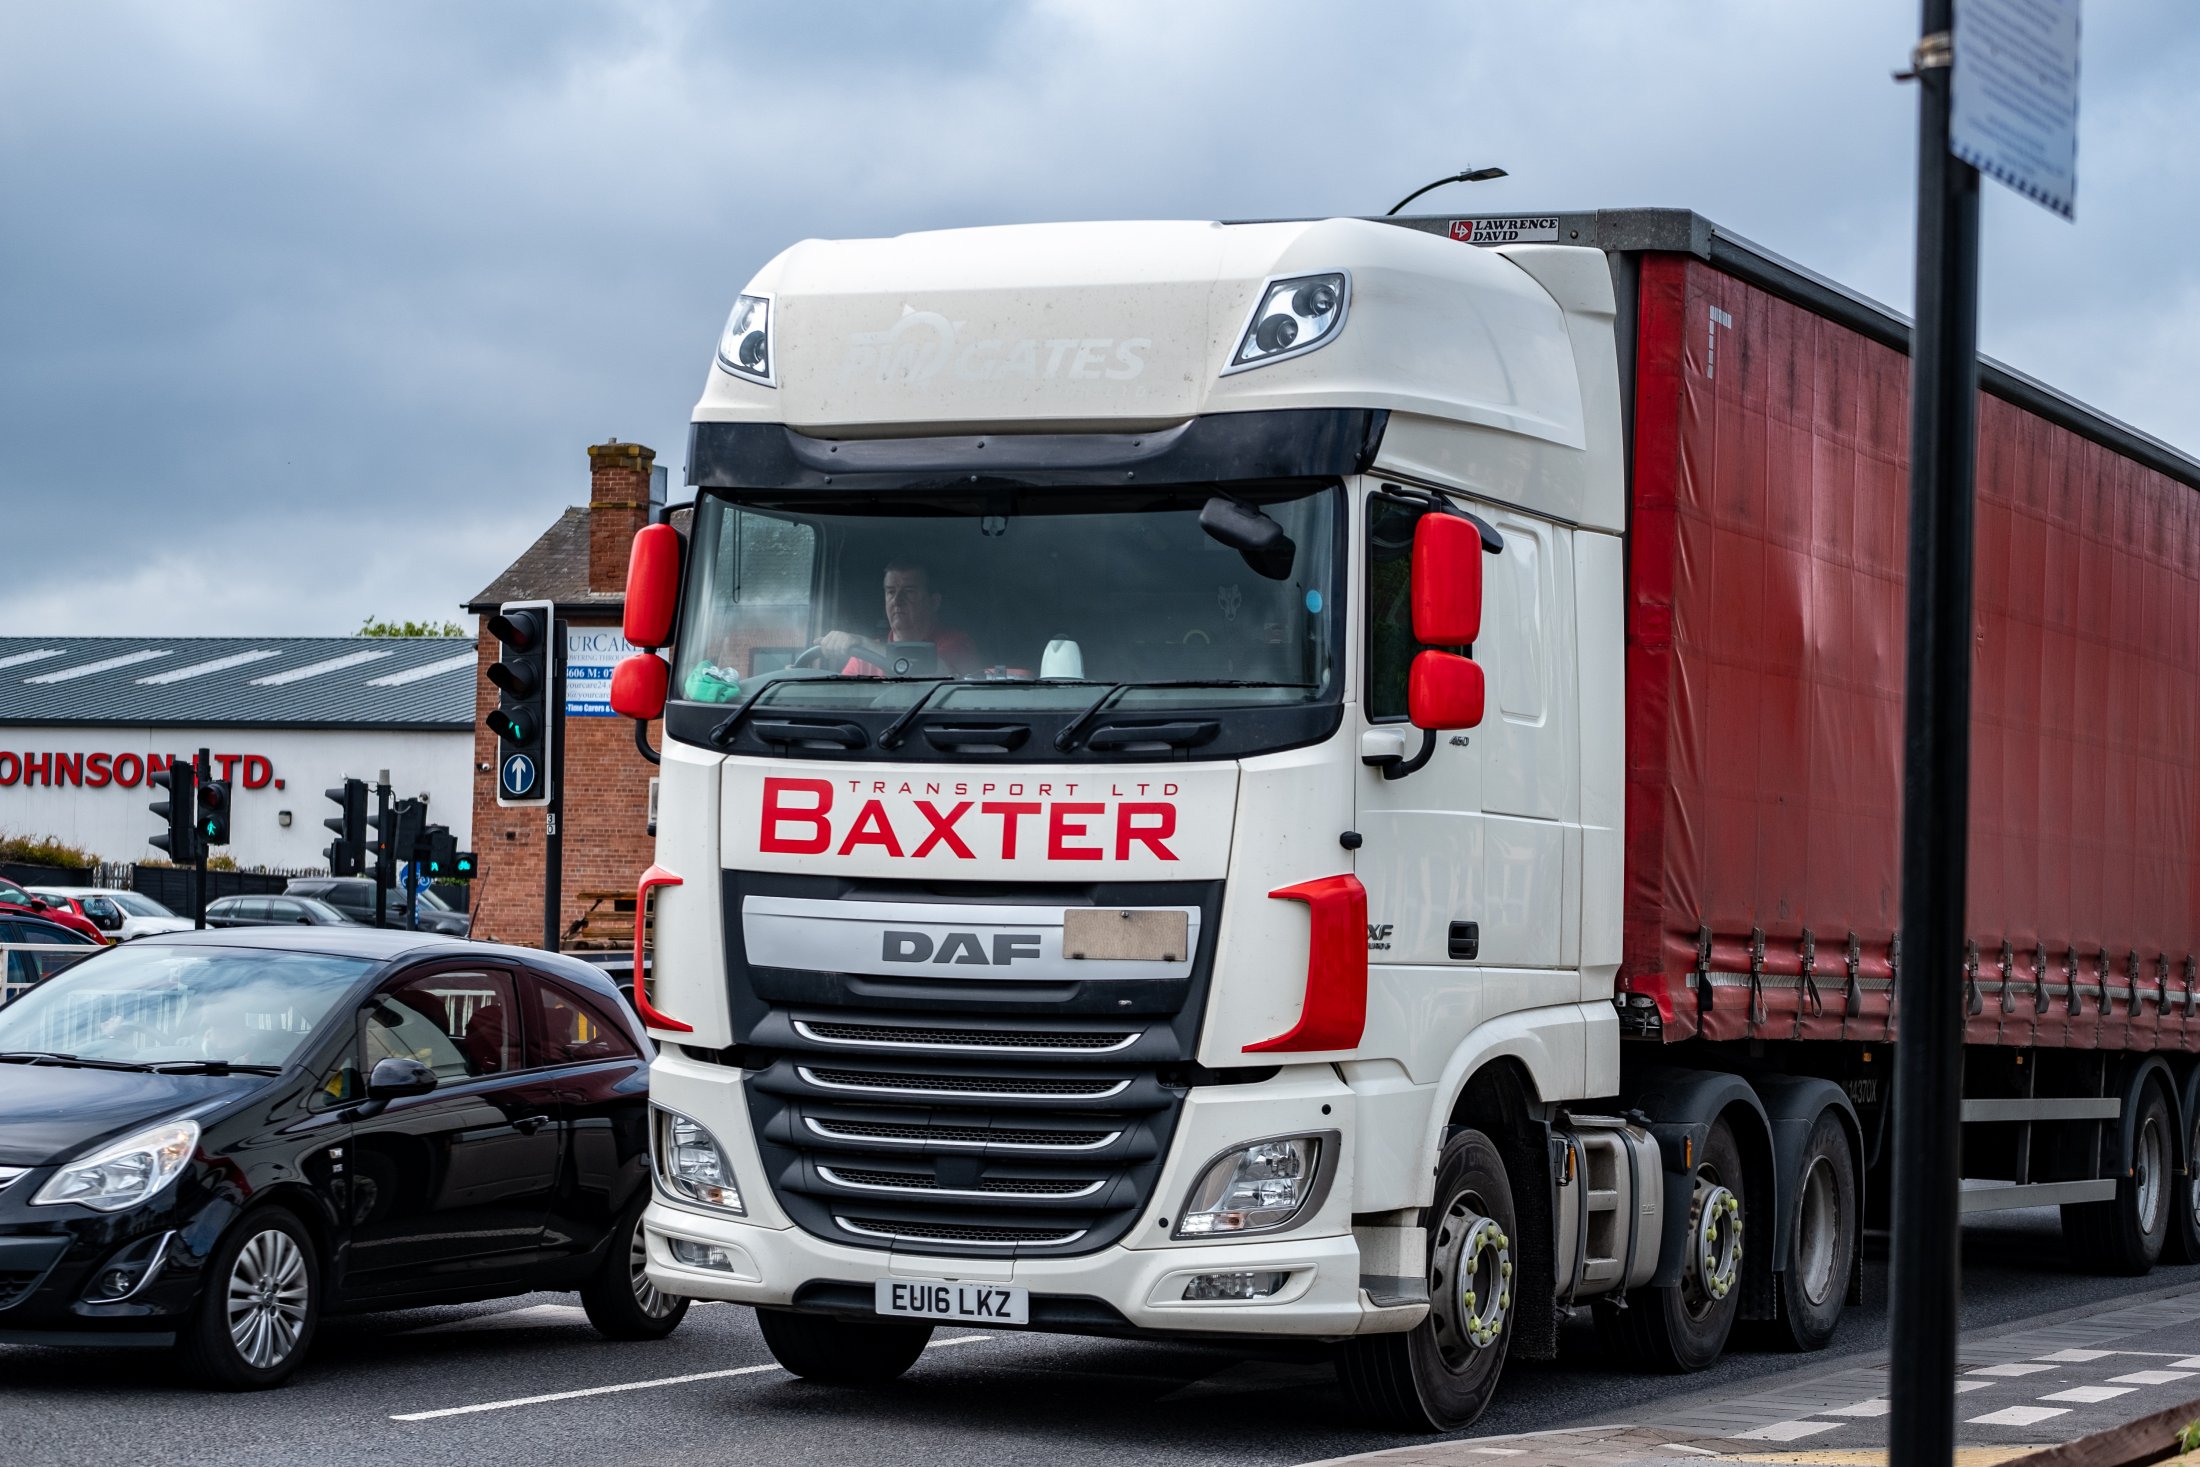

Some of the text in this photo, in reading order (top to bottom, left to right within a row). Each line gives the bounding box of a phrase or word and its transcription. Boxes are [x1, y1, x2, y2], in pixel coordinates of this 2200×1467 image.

[1473, 232, 1519, 241] DAVID
[1474, 219, 1558, 230] LAWRENCE
[566, 668, 585, 678] 606
[192, 753, 285, 790] TD.
[848, 780, 1179, 796] TRANSPORT LTD
[759, 777, 1180, 861] BAXTER
[882, 930, 1041, 966] DAF
[892, 1283, 1011, 1317] EU16 LKZ
